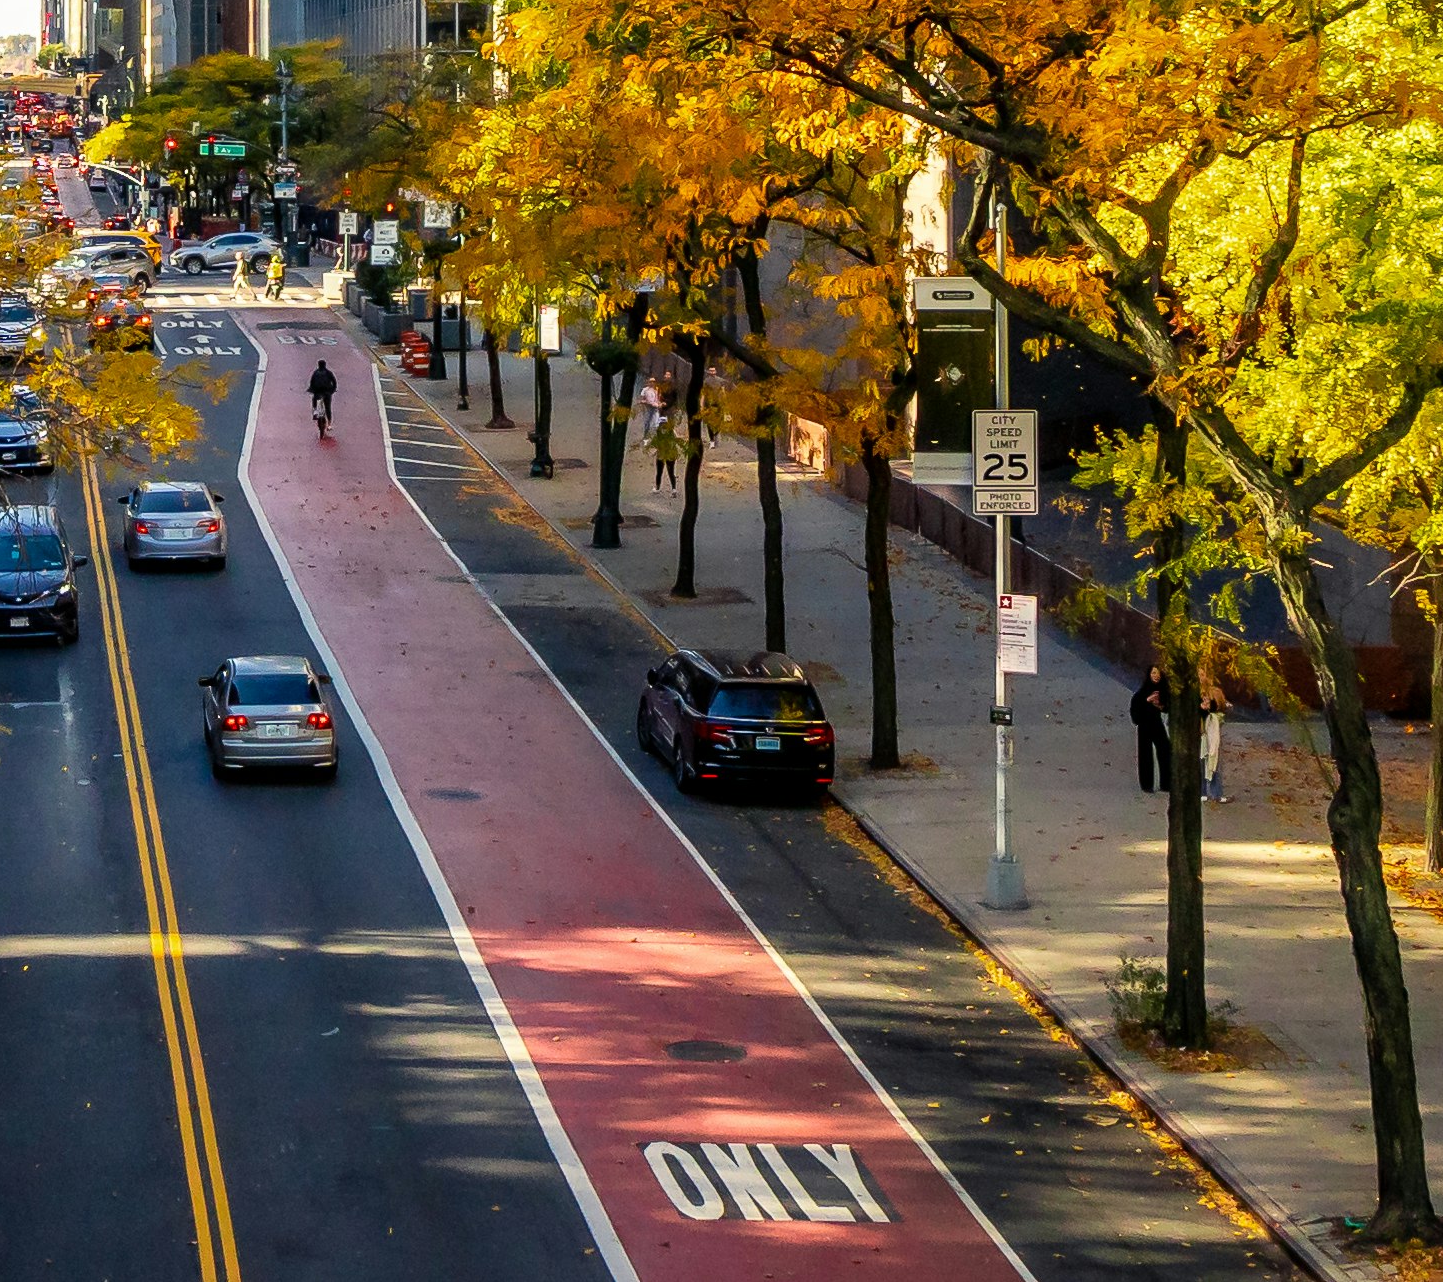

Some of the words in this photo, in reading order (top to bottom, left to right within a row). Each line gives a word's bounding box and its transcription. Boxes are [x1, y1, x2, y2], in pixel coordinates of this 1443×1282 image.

[160, 320, 224, 329] ONLY
[277, 335, 338, 346] BUS
[173, 346, 243, 356] ONLY
[991, 416, 1016, 424] CITY
[986, 428, 1022, 437] SPEED
[990, 440, 1019, 449] LIMIT
[982, 453, 1029, 481] 25
[989, 493, 1022, 501] PHOTO
[980, 502, 1031, 510] ENFORCED
[643, 1141, 891, 1223] ONLY
